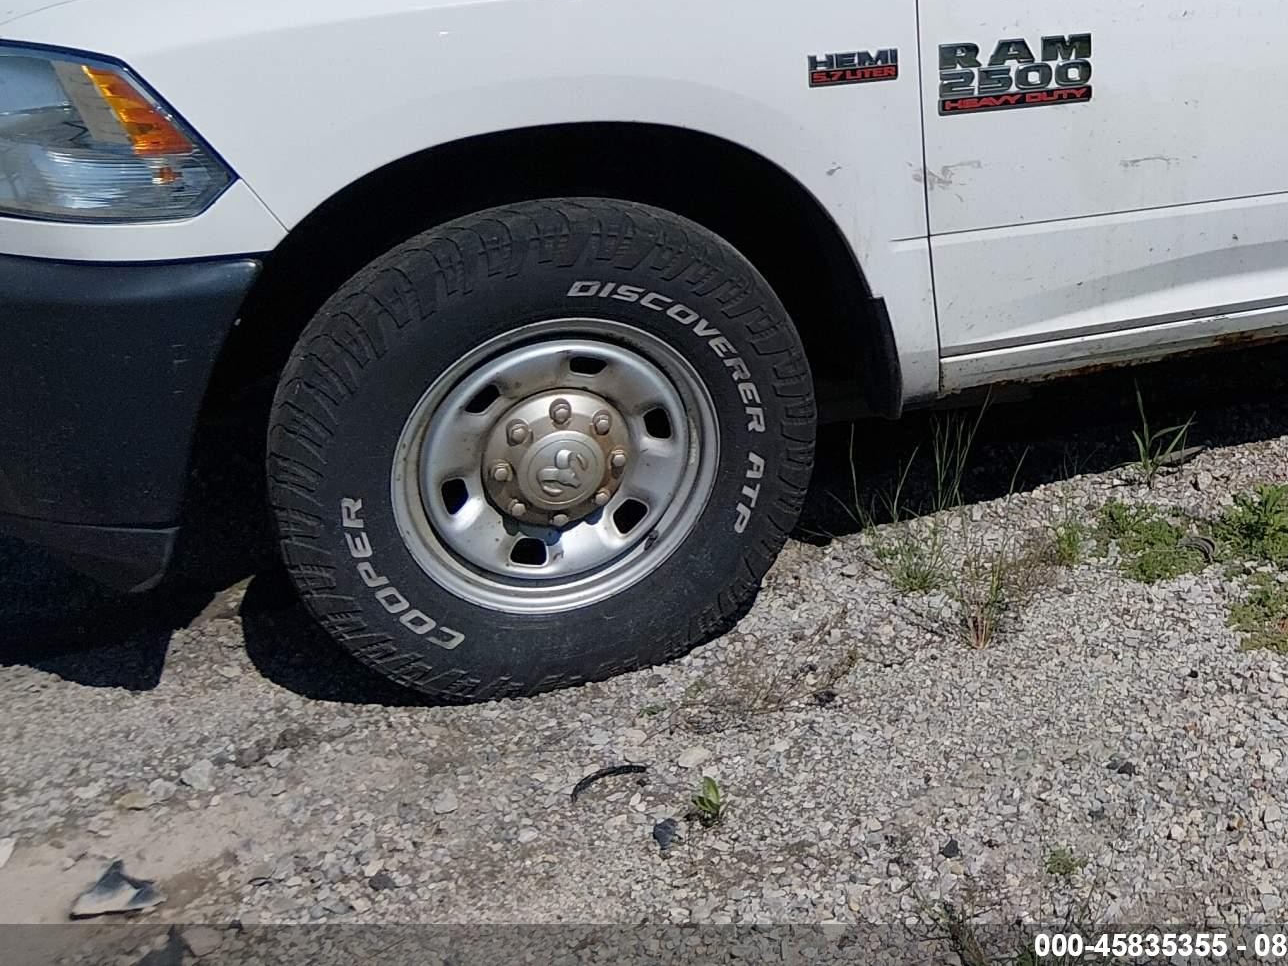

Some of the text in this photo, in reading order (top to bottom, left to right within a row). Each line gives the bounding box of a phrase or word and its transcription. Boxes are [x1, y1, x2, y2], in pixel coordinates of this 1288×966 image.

[808, 48, 897, 70] HEMI
[938, 33, 1092, 70] RAM
[811, 66, 897, 83] 5.7 LITER
[939, 59, 1092, 99] 2500
[944, 87, 1090, 111] HEAVY DUTY
[566, 280, 766, 534] DISCOVERER ATP
[341, 497, 465, 650] COOPER
